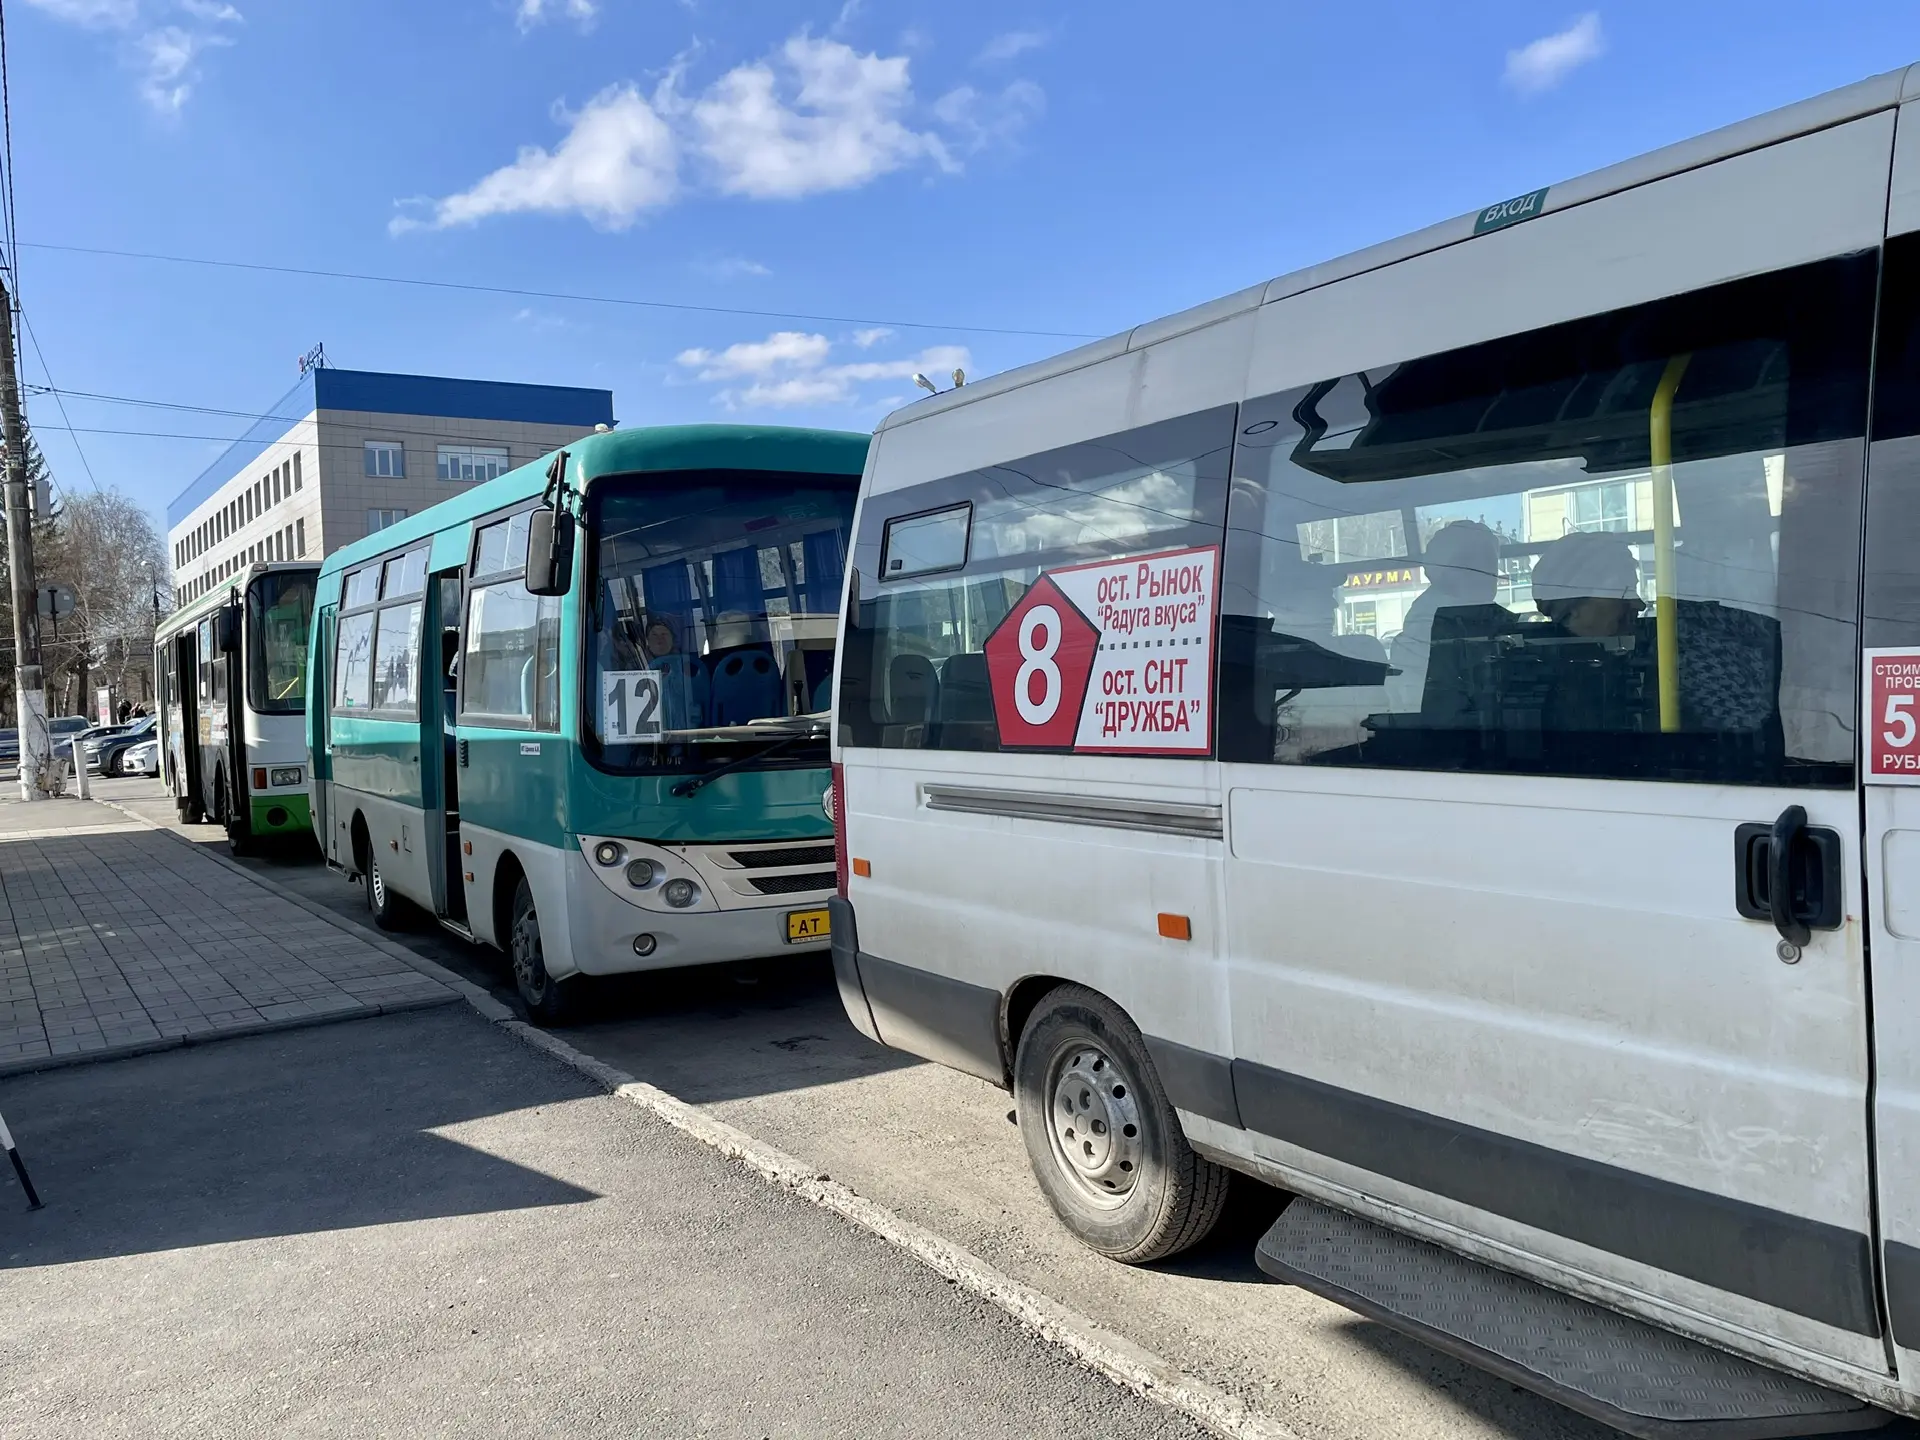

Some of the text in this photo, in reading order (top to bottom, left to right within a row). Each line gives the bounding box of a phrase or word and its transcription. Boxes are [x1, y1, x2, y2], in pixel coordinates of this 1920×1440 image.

[1484, 193, 1539, 223] ВХОД
[1014, 603, 1063, 726] 8
[1102, 658, 1189, 696] ост. СНТ
[609, 678, 660, 735] 12
